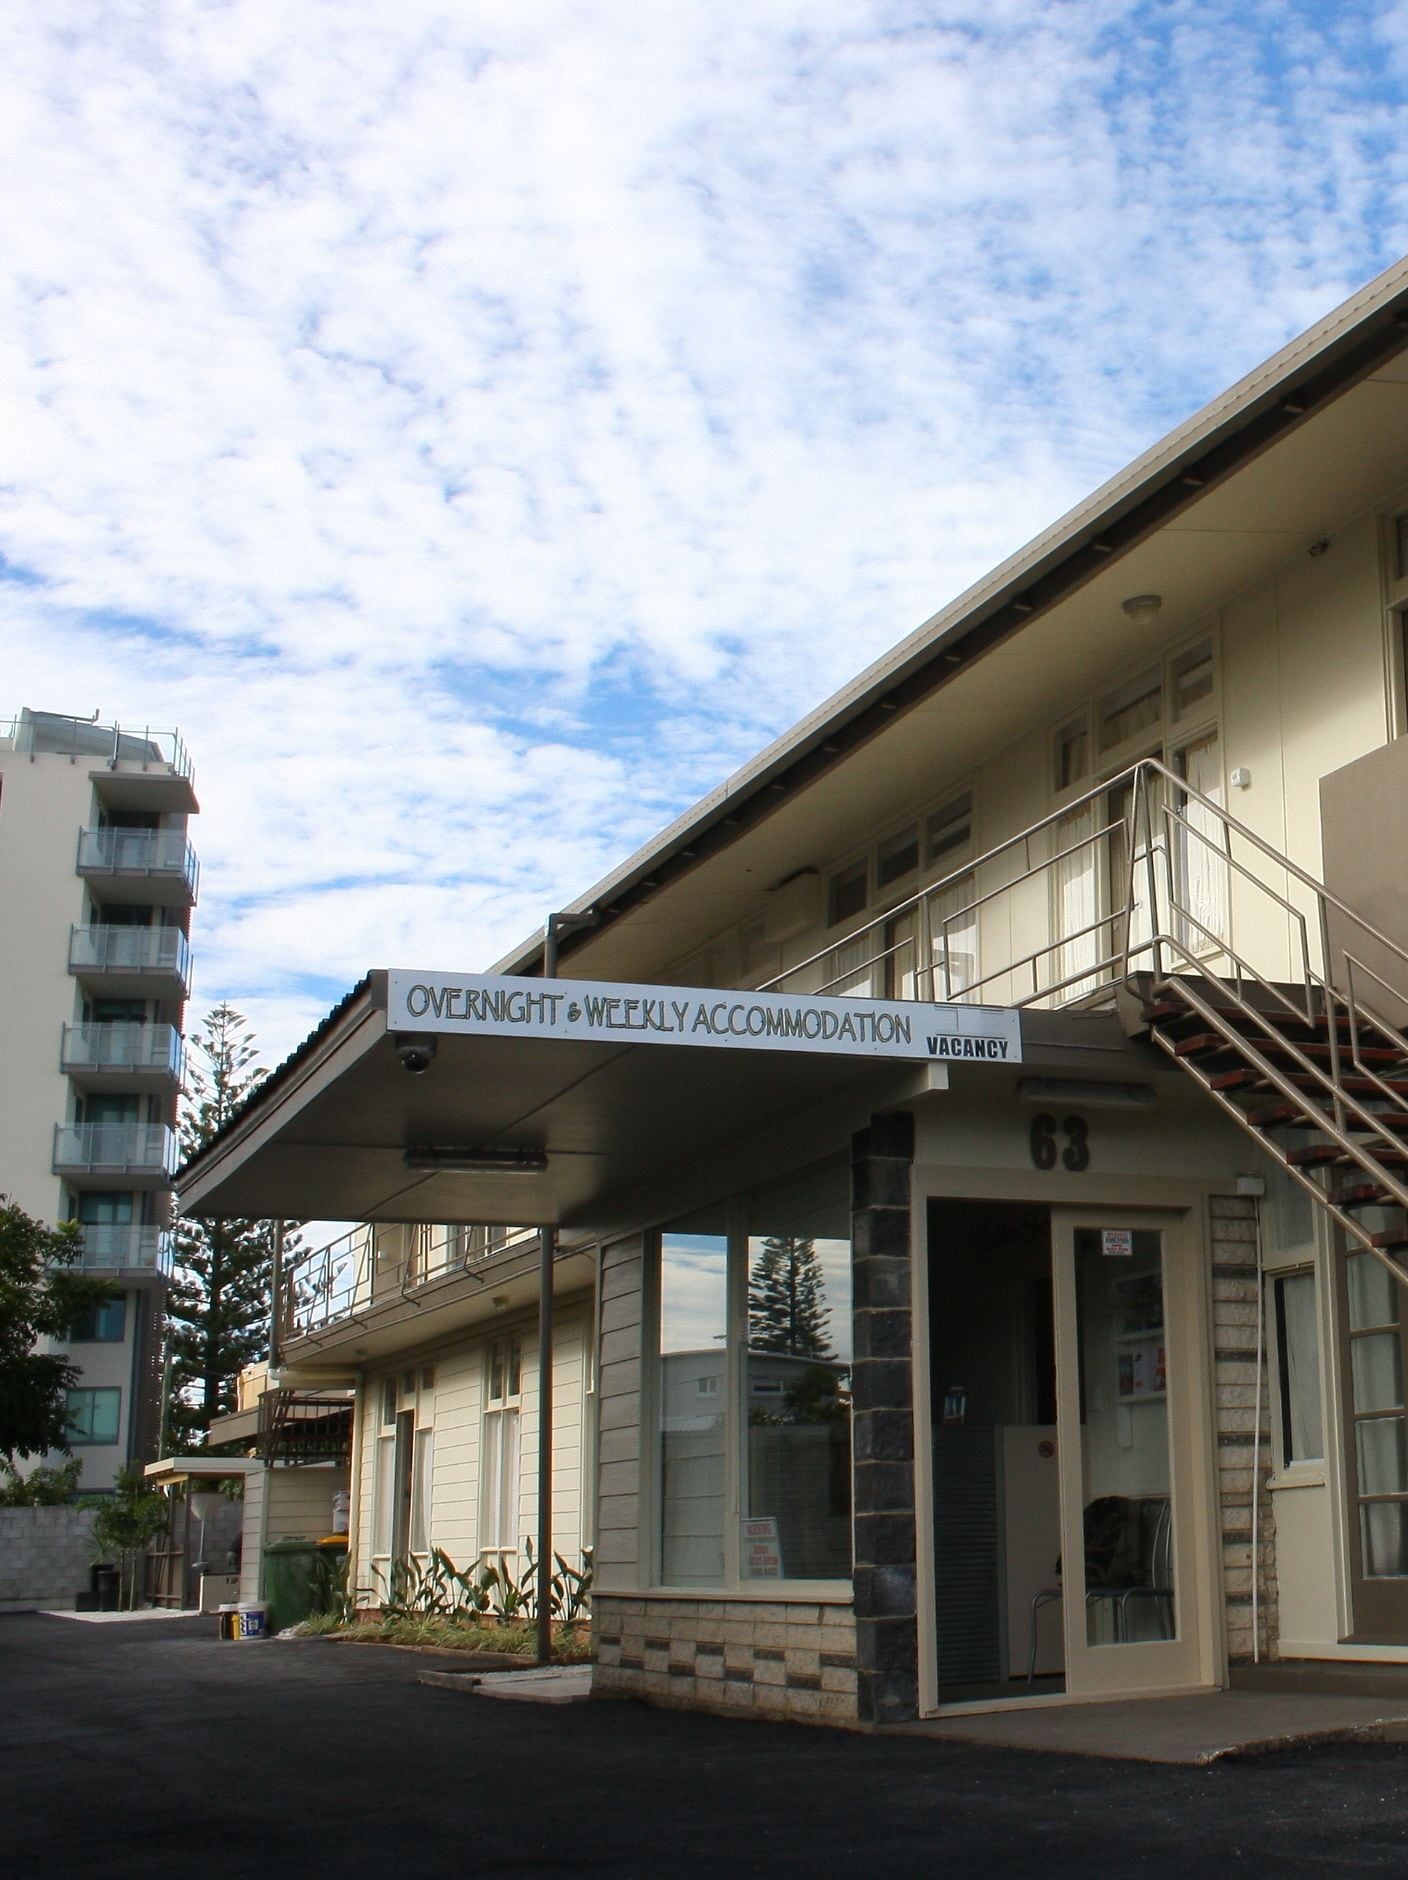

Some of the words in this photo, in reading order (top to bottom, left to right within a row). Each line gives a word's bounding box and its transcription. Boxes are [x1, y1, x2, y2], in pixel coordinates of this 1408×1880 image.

[406, 984, 565, 1026] OVERNIGHT
[567, 1002, 582, 1022] &
[585, 994, 689, 1033] WEEKLY
[692, 1001, 912, 1044] ACCOMMODATION
[926, 1036, 1009, 1060] VACANCY
[1030, 1112, 1091, 1172] 63
